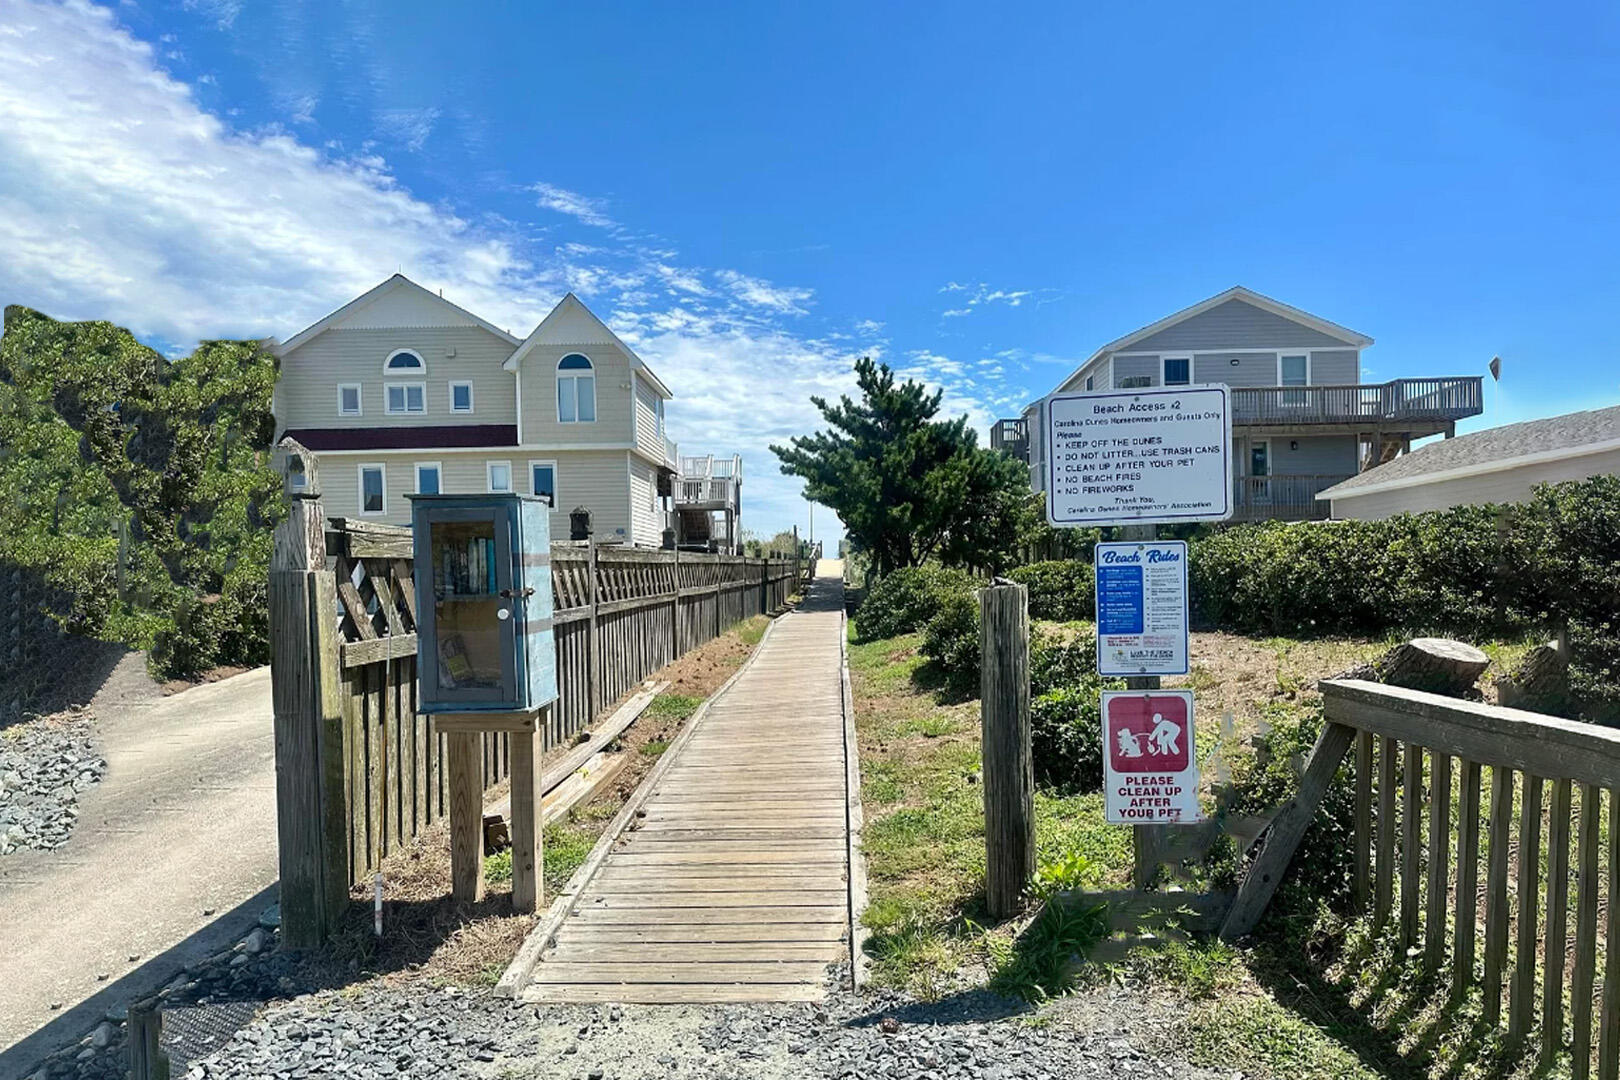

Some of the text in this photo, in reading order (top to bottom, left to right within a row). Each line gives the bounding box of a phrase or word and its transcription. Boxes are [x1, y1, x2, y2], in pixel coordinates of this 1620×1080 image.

[1093, 404, 1124, 414] Beach
[1129, 402, 1166, 412] Access
[1065, 436, 1162, 449] KEEP OFF THE DUNES
[1065, 453, 1078, 462] DO
[1081, 452, 1098, 460] NOT
[1162, 447, 1192, 455] TRASH
[1065, 464, 1095, 472] CLEAN
[1115, 461, 1145, 470] AFTER
[1150, 460, 1173, 468] YOUR
[1082, 474, 1112, 483] BEACH
[1116, 472, 1141, 481] FIRES
[1082, 485, 1134, 494] FIREWORKS
[1102, 550, 1179, 564] Beach Rules
[1126, 776, 1174, 785] PLEASE
[1118, 787, 1182, 796] CLEAN UP
[1130, 798, 1171, 807] AFTER
[1119, 808, 1182, 817] YOUR PET
